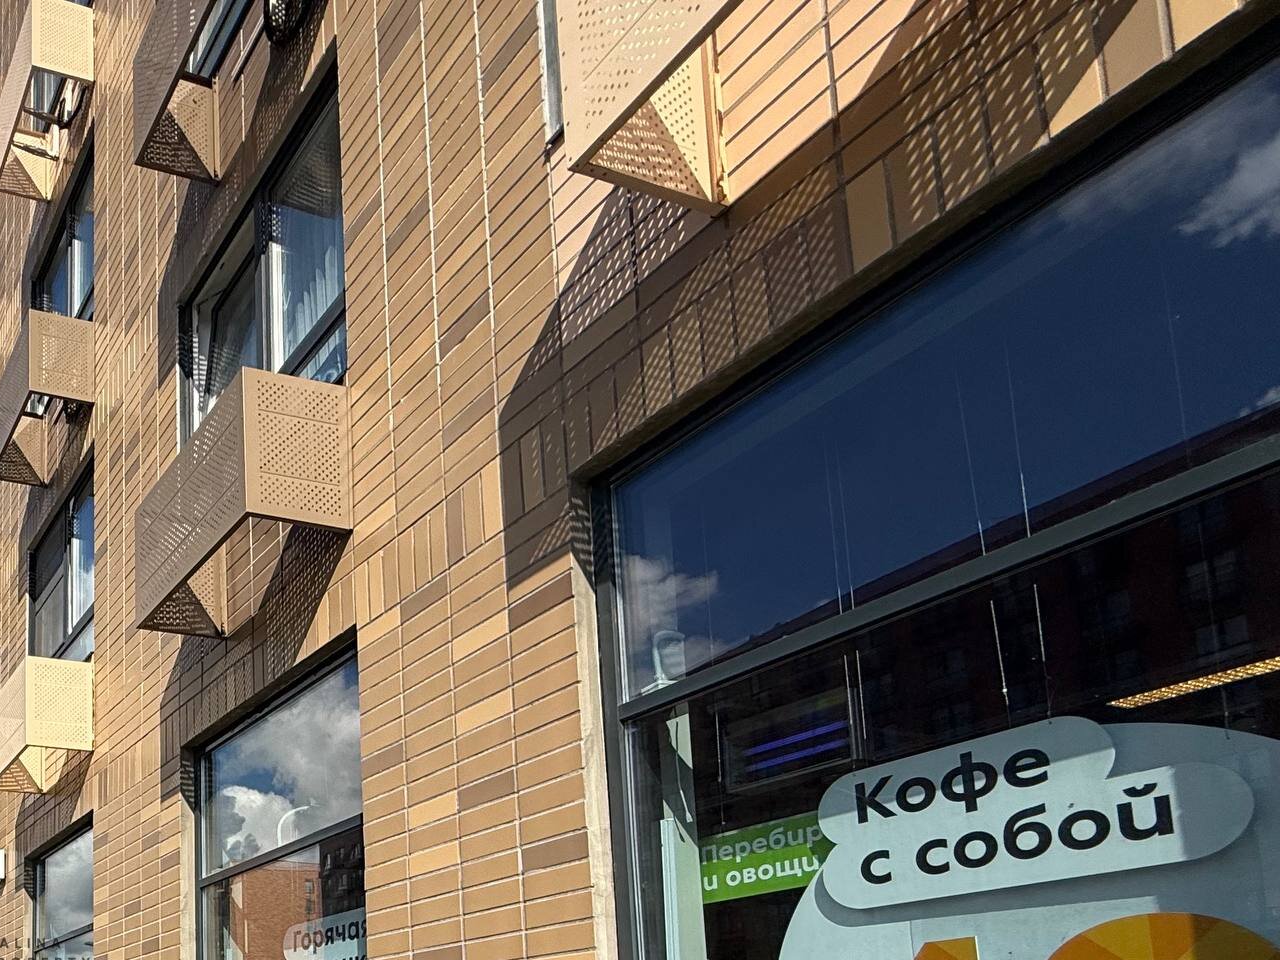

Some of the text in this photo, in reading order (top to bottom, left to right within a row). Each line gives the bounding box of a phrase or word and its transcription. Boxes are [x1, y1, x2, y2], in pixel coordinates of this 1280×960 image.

[854, 748, 1050, 824] Кофе
[701, 824, 823, 865] Перебир
[860, 782, 1175, 884] с собой
[703, 854, 820, 891] и овощи
